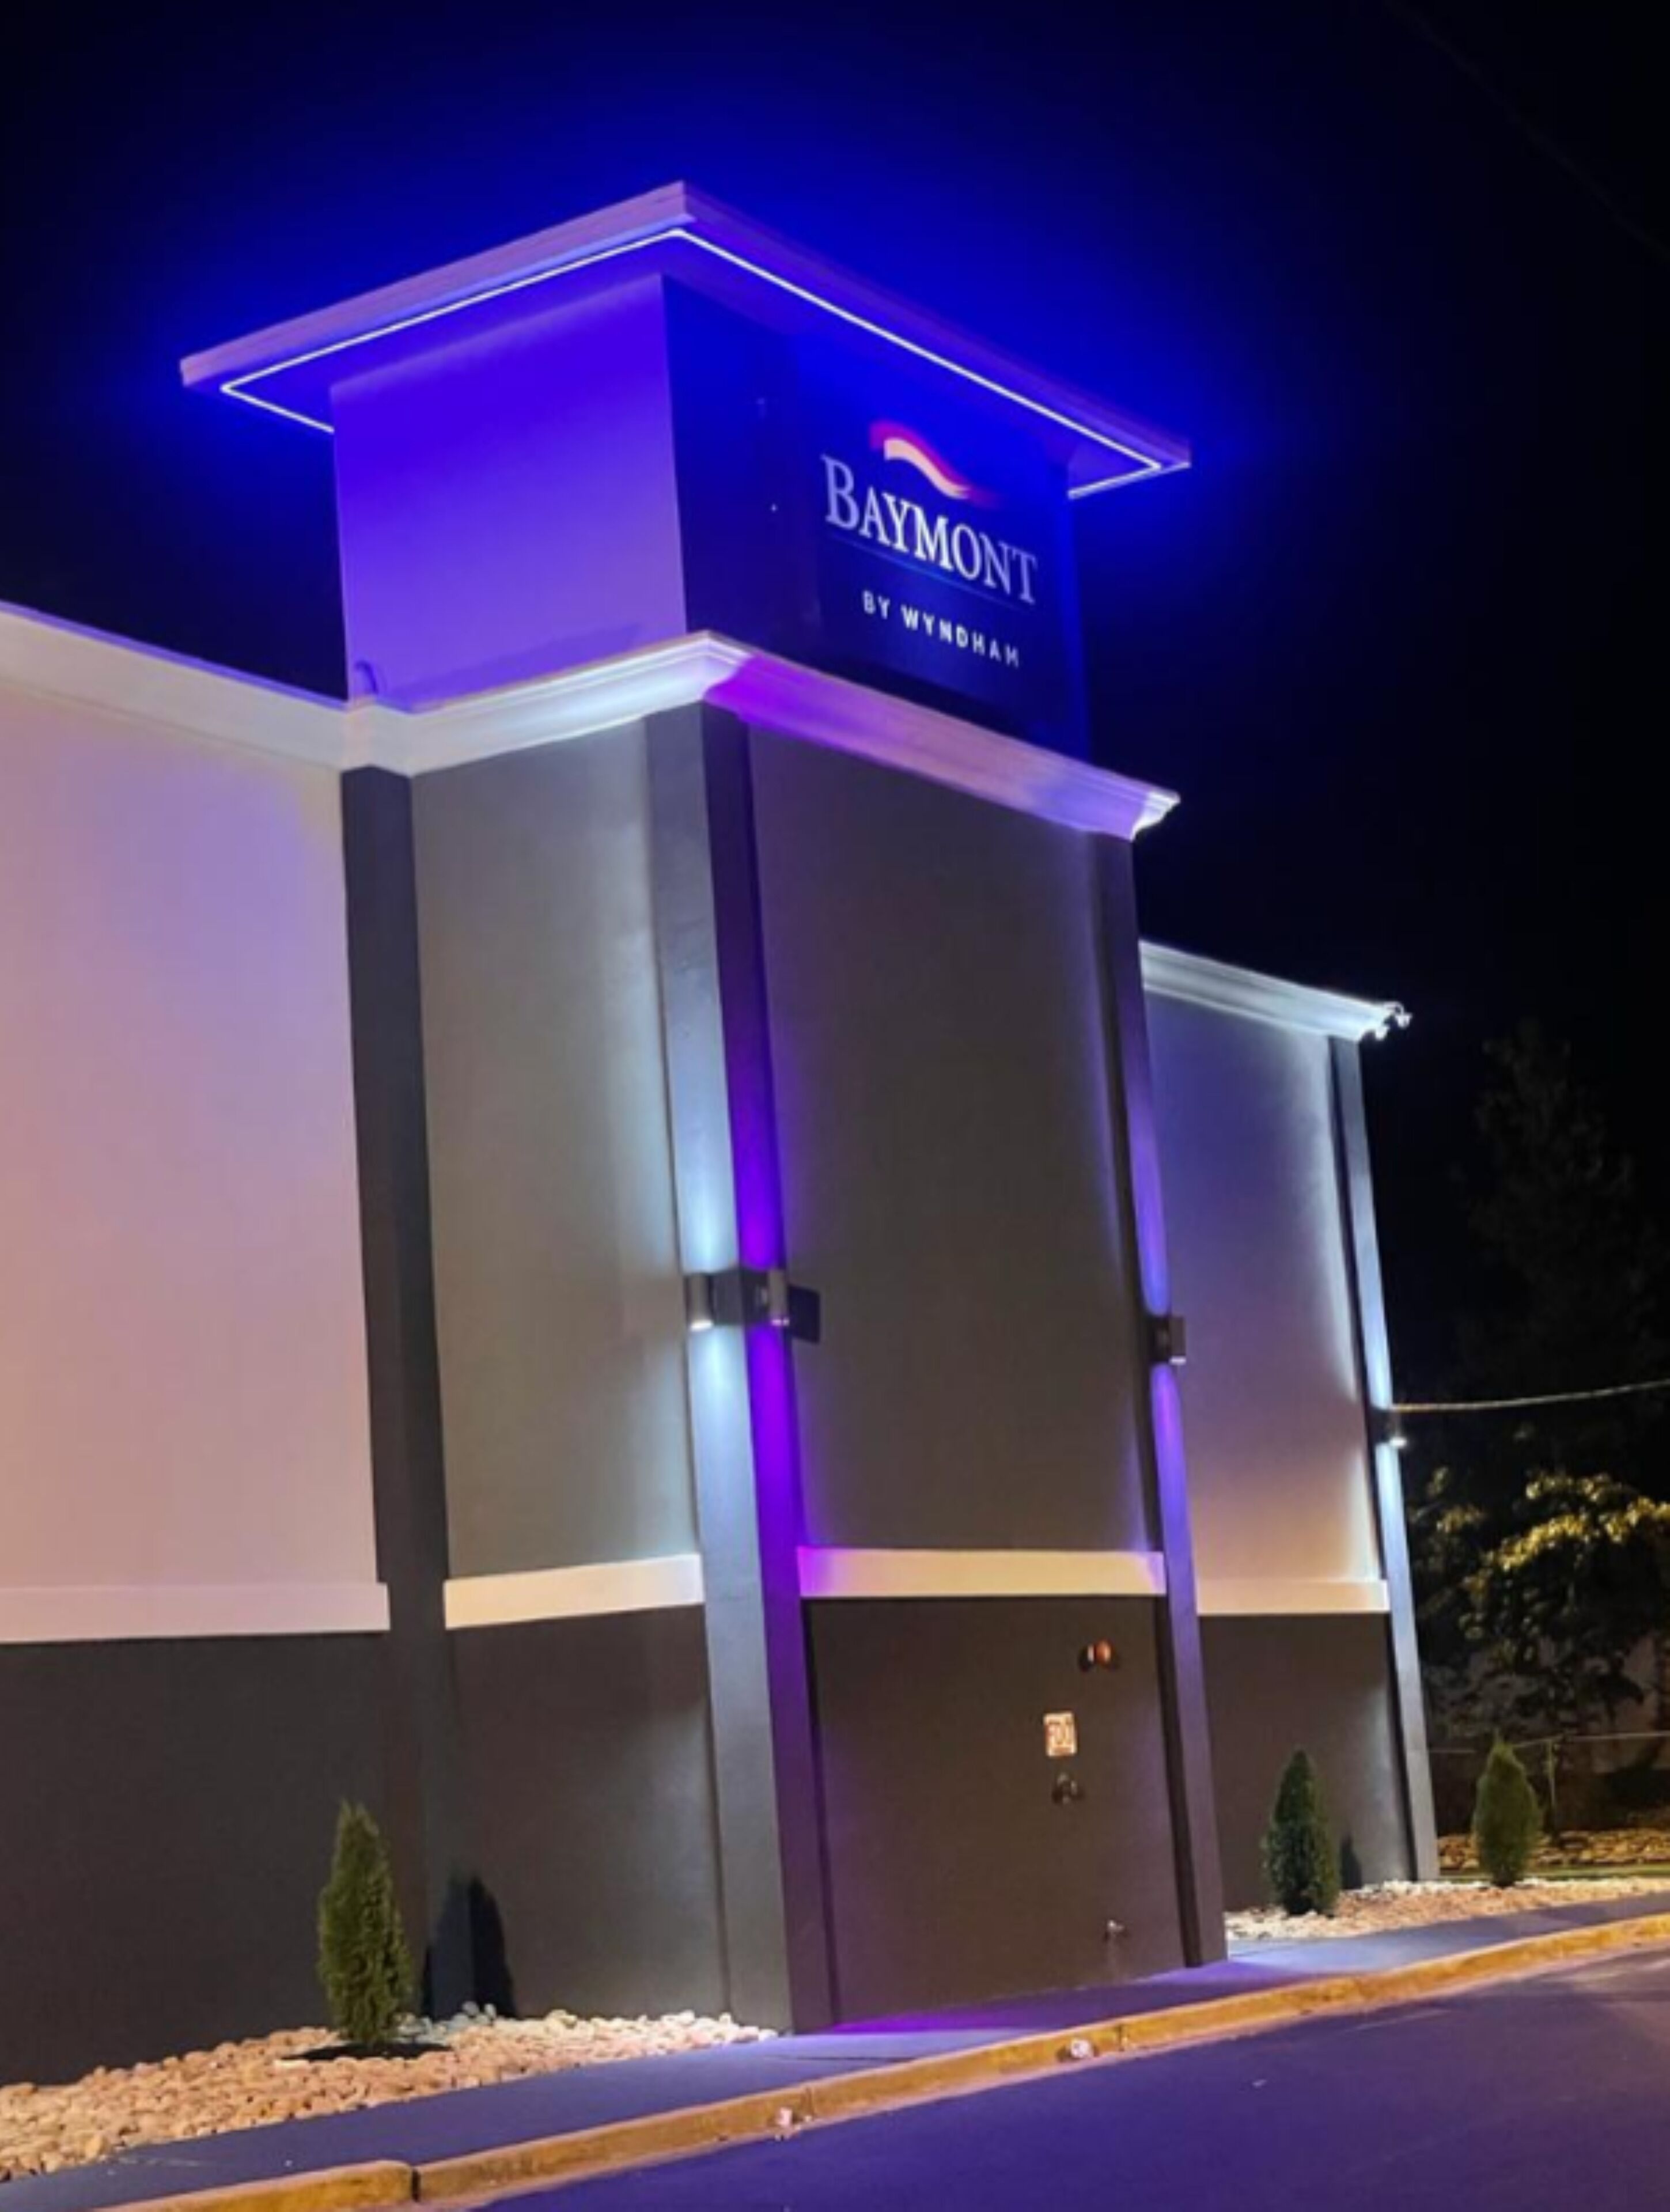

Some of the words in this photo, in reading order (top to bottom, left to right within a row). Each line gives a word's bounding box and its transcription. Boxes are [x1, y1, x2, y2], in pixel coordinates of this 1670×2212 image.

[821, 454, 1037, 605] BAYMONT
[863, 590, 891, 619] BY
[901, 605, 1020, 668] WYNDHAM
